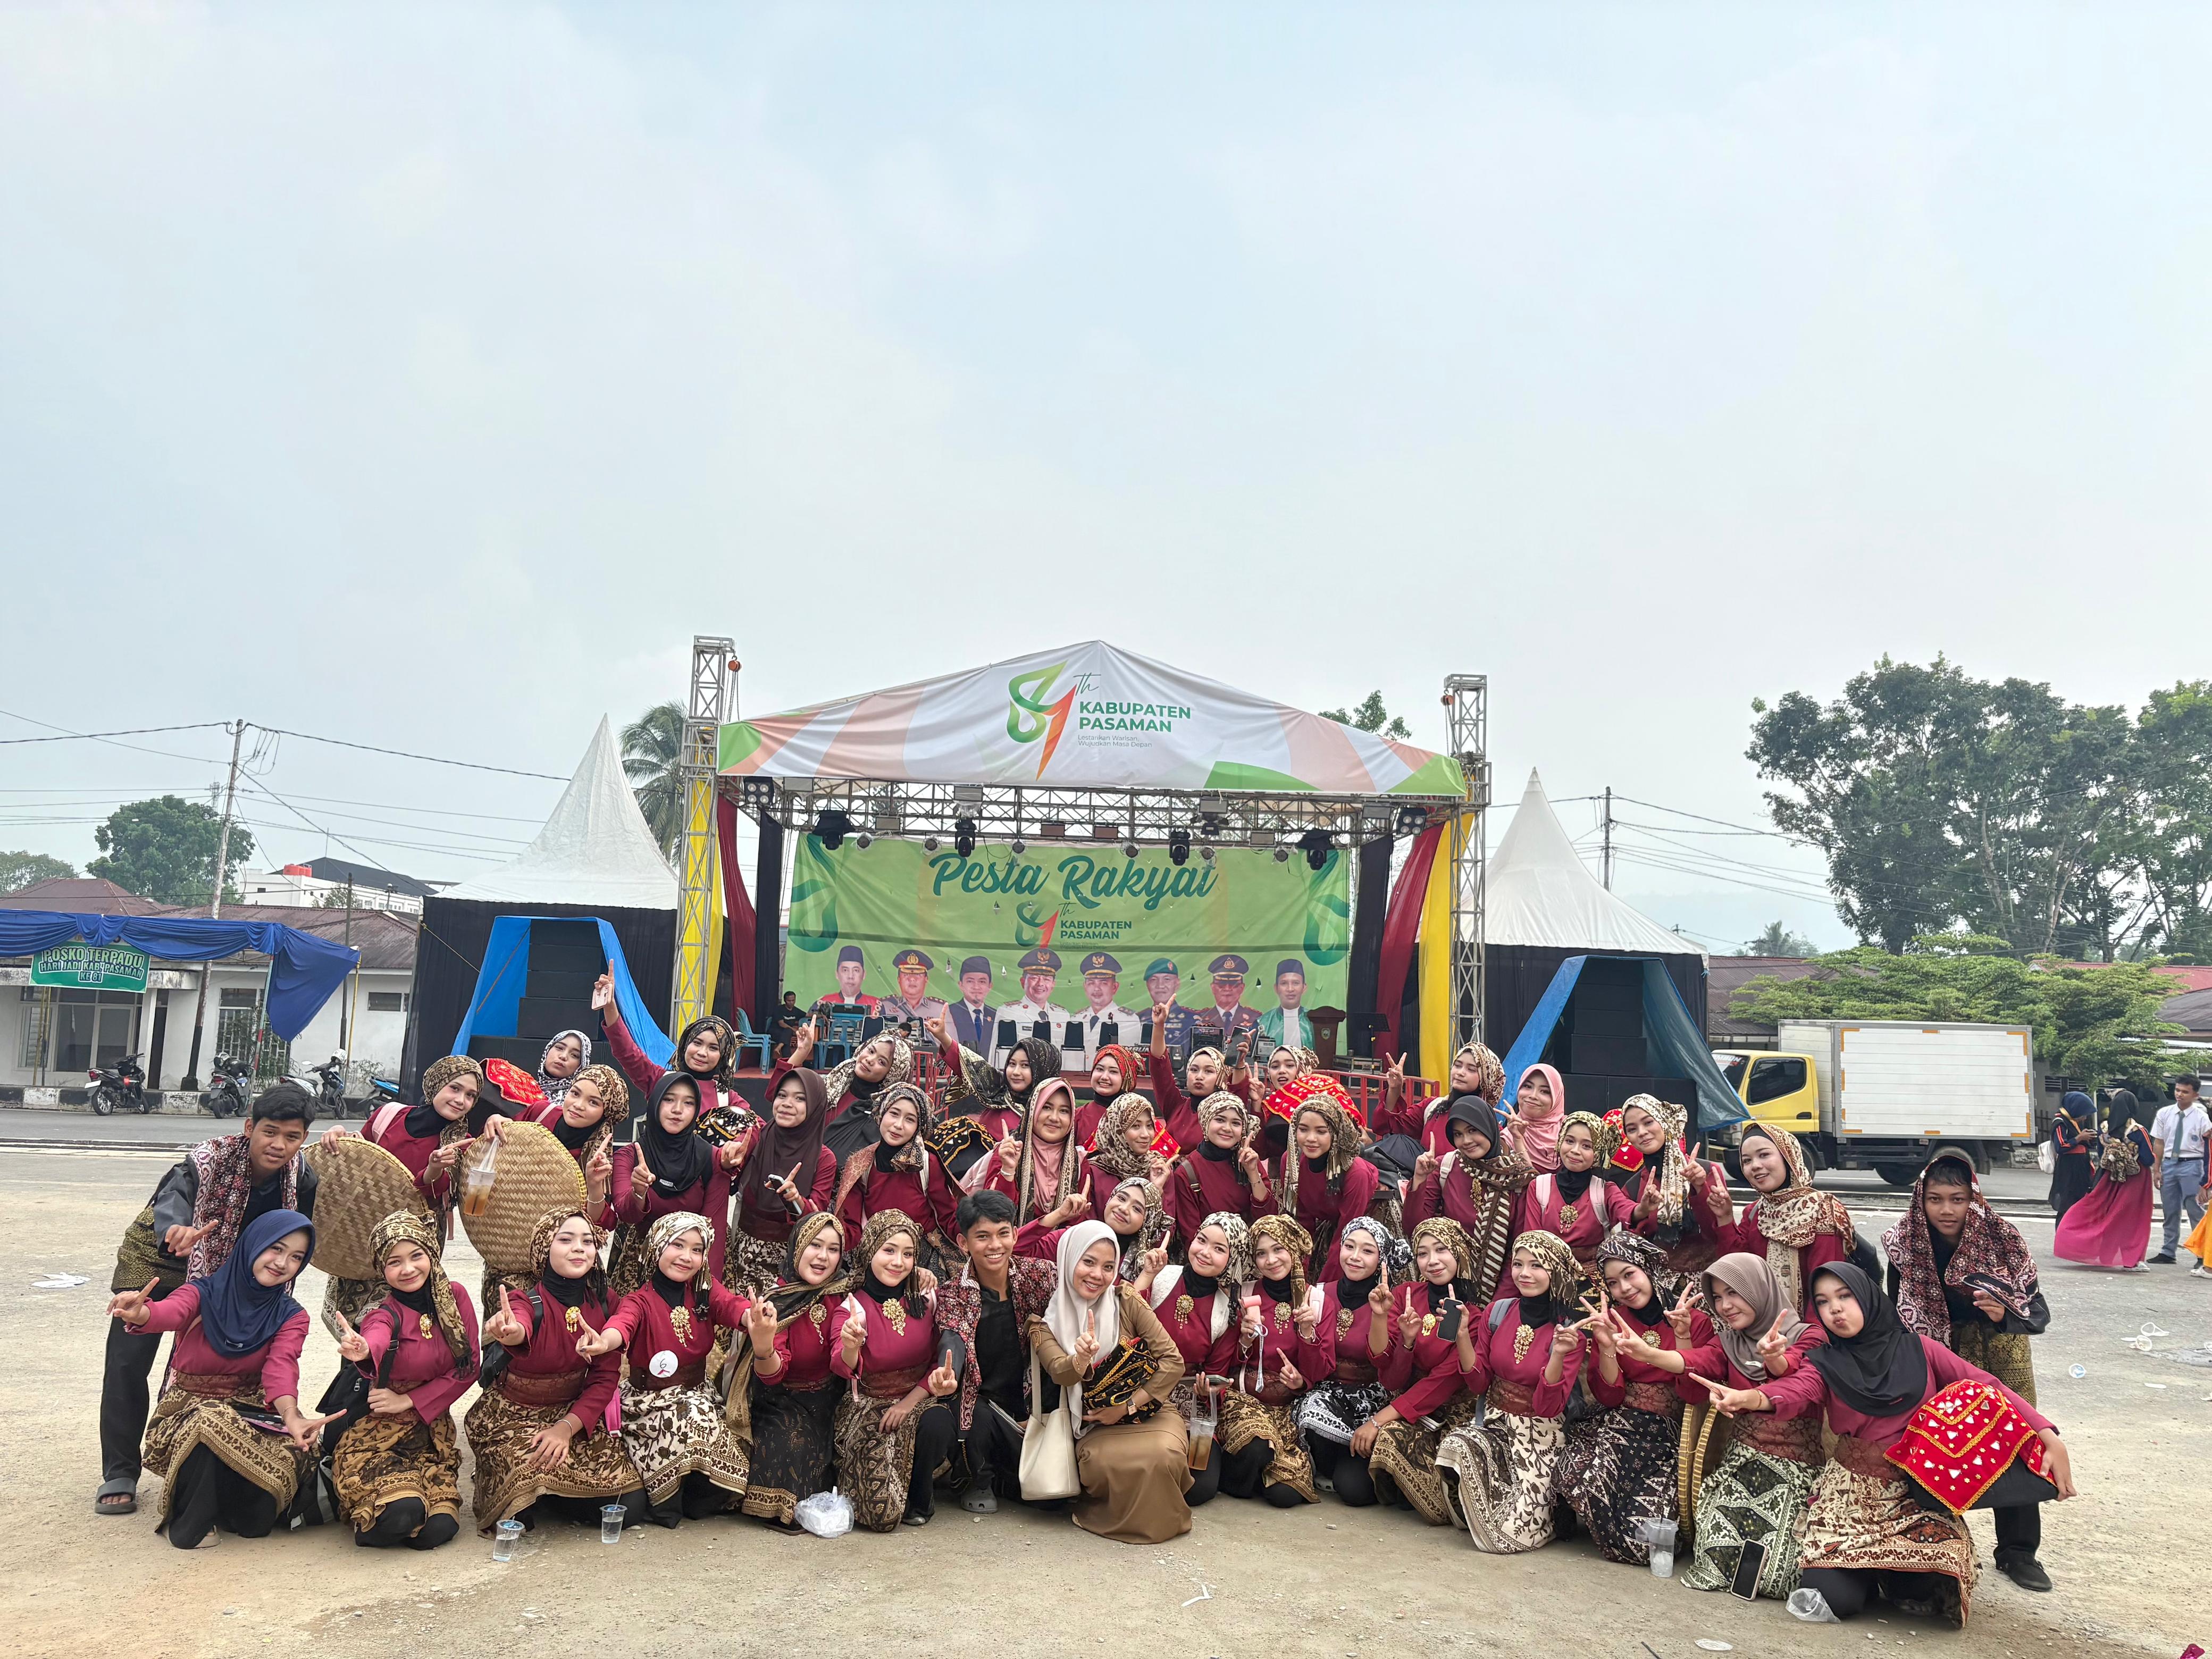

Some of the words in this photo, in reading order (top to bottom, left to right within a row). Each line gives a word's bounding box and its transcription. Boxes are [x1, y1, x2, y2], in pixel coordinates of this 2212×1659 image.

[1079, 701, 1191, 719] KABUPATEN
[1079, 717, 1171, 733] PASAMAN
[928, 852, 1050, 896] Pesta
[1058, 855, 1219, 911] Rakyat
[1060, 920, 1132, 929] KABUPATEN
[1060, 931, 1119, 940] PASAMAN
[43, 948, 86, 962] POSKO
[88, 948, 145, 969] TERPADU
[40, 961, 61, 971] HARI
[62, 961, 81, 970] JADI
[104, 963, 143, 978] PASAMAN
[80, 972, 91, 981] KE
[92, 973, 102, 982] 81
[659, 1358, 667, 1369] 6
